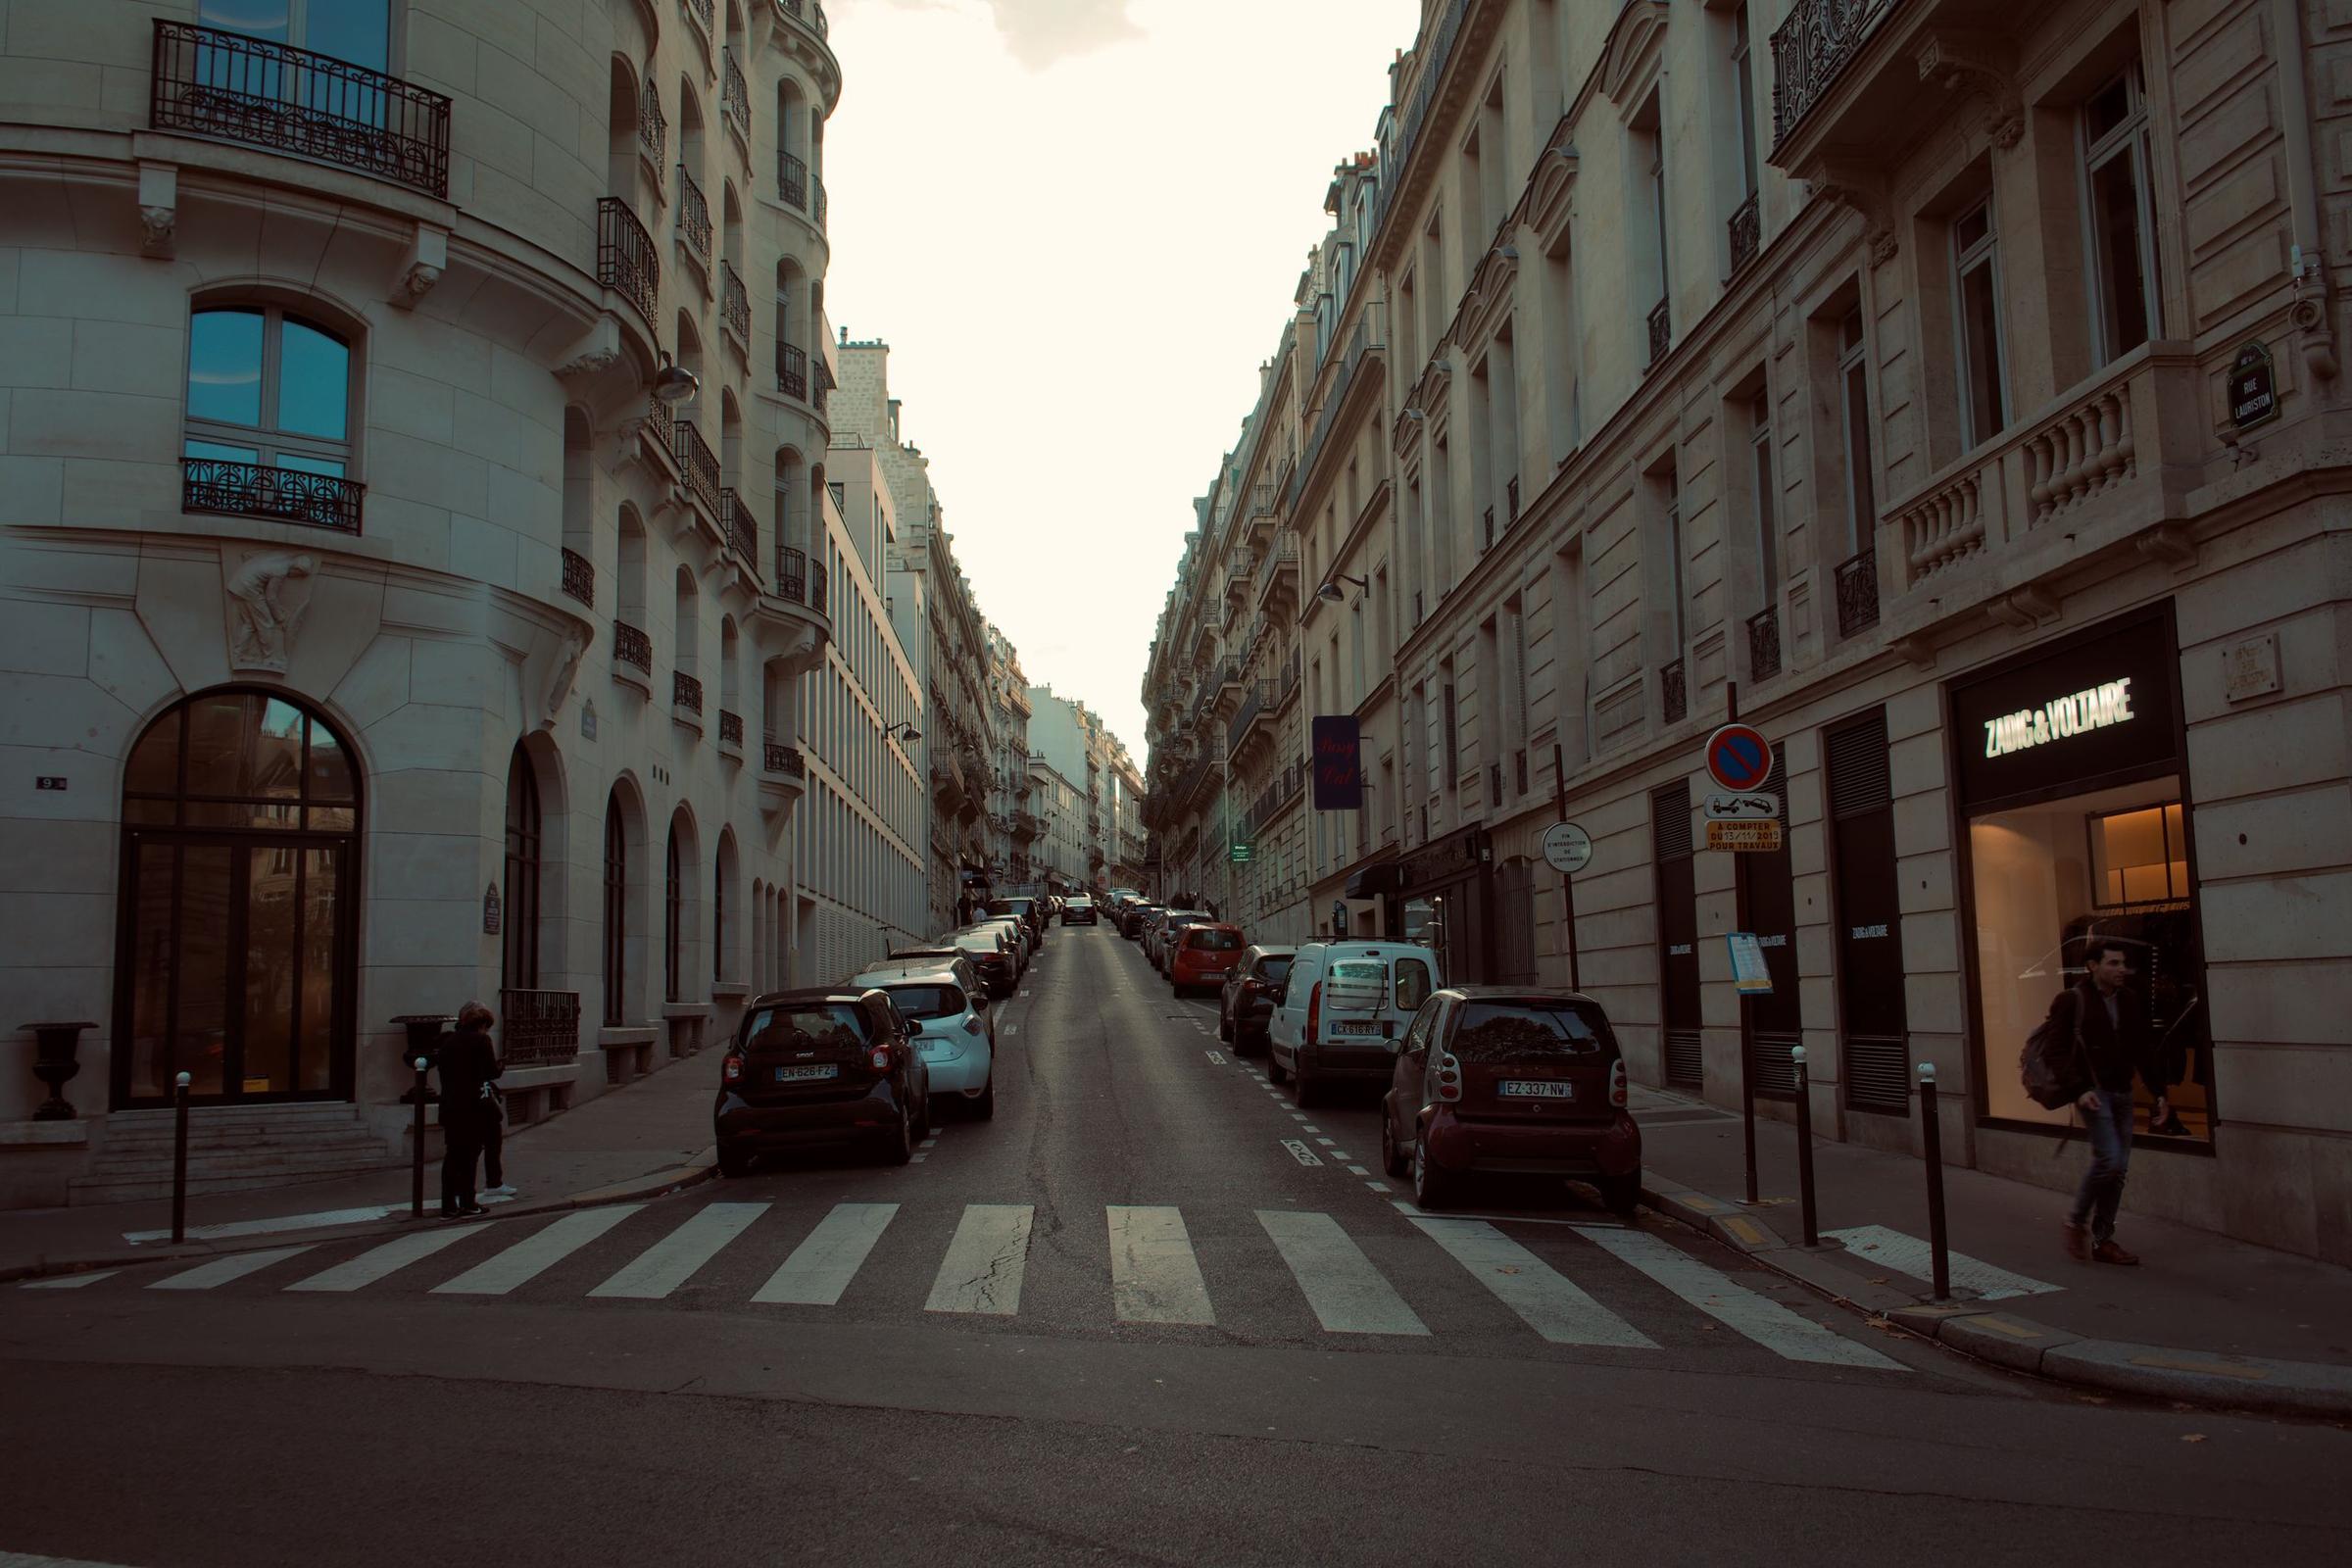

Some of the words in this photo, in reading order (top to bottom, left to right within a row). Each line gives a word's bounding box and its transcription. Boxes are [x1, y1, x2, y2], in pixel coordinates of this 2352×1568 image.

[2243, 377, 2258, 395] RUE
[2234, 392, 2272, 419] LAURISTON
[1984, 677, 2134, 759] ZADIG&VOLTAIRE
[42, 778, 52, 788] 9
[1507, 1082, 1565, 1096] EZ-337-NW
